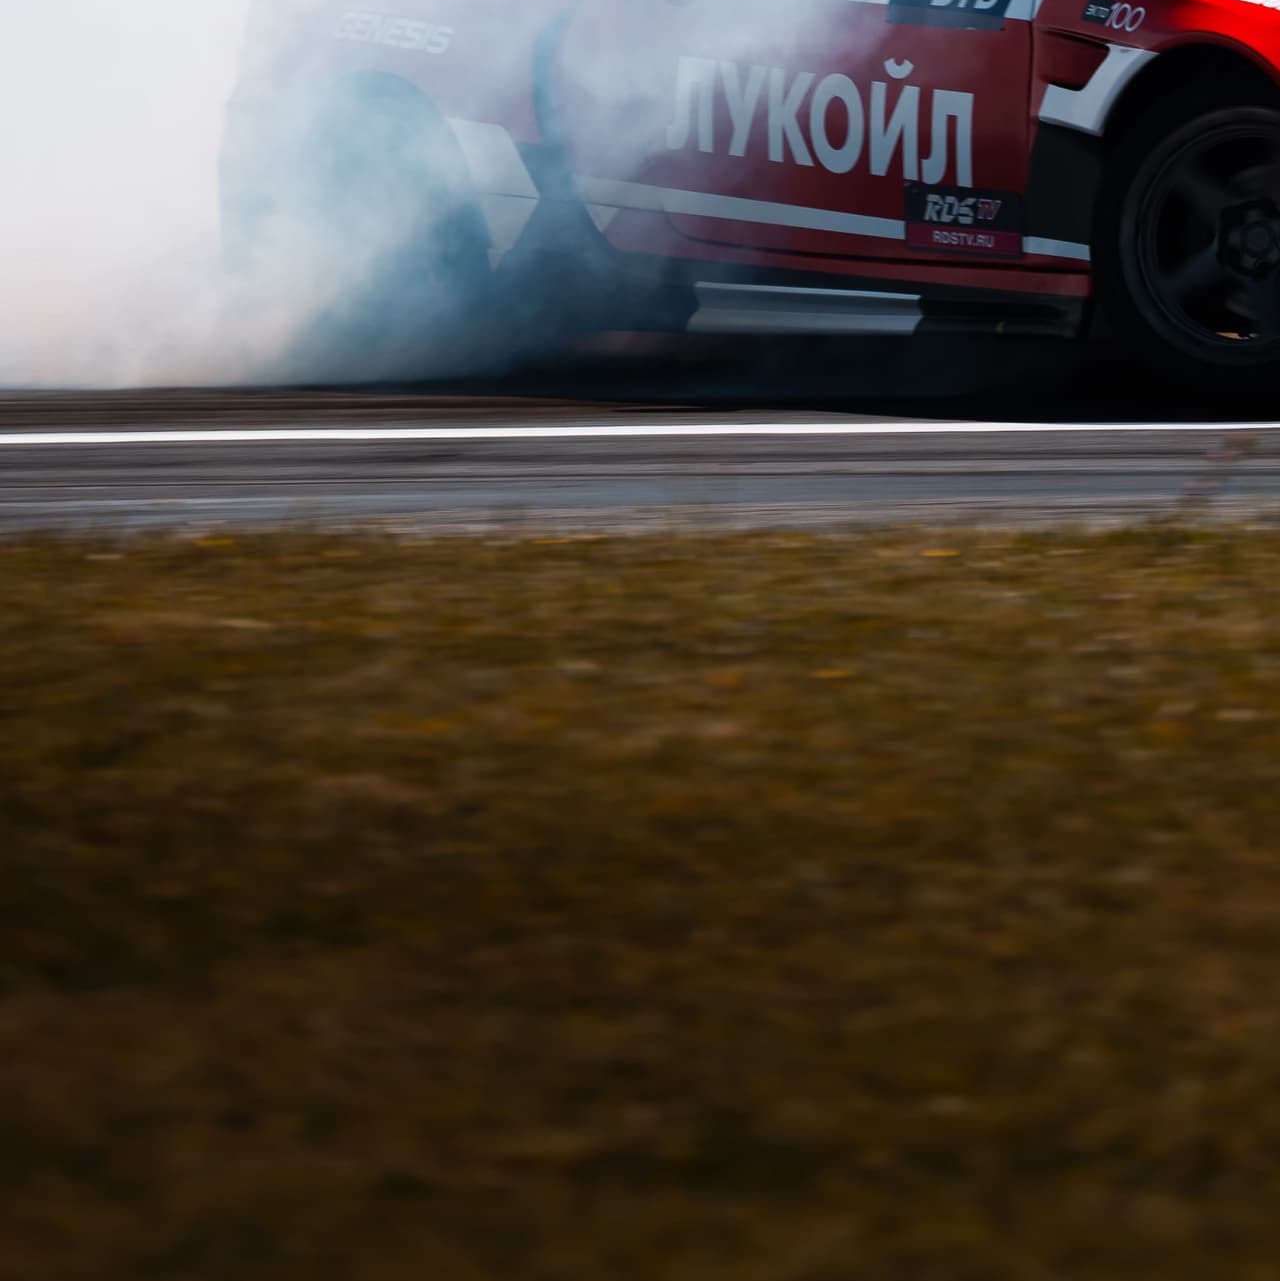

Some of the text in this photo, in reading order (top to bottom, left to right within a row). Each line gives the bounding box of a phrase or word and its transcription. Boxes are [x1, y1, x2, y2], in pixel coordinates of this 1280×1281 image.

[667, 56, 975, 188] ЛУКОЙЛ
[924, 194, 976, 224] RDS
[932, 229, 995, 248] RDSTV.RU
